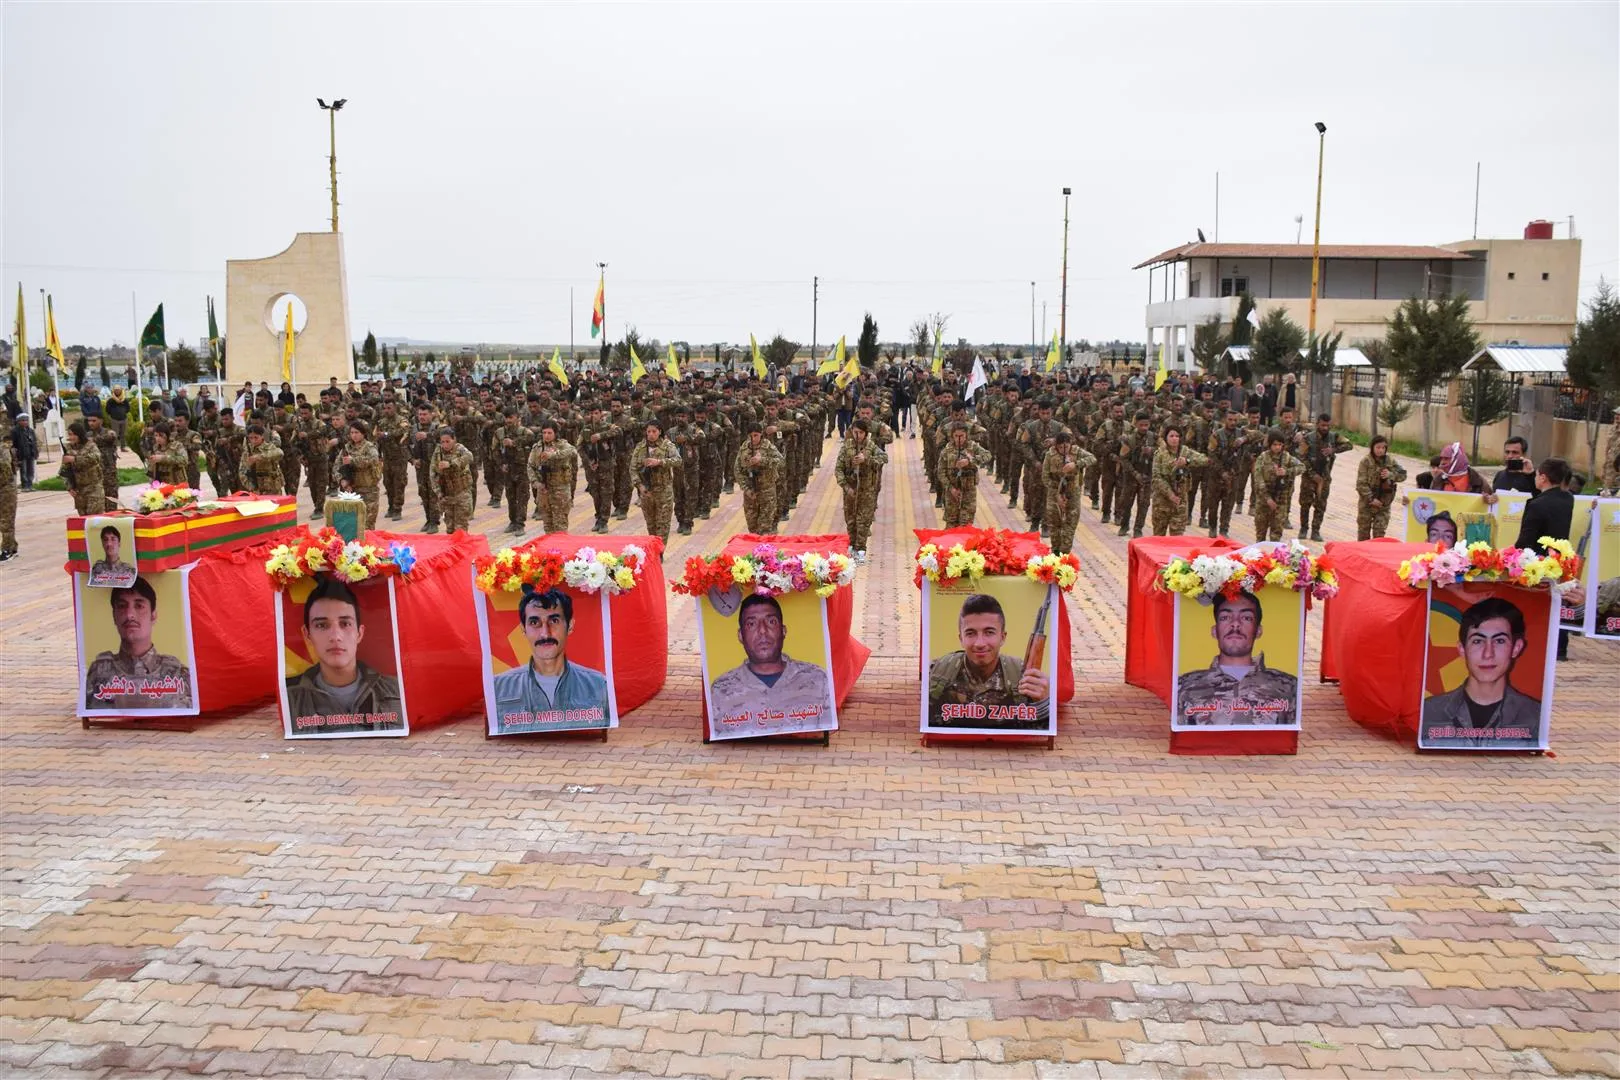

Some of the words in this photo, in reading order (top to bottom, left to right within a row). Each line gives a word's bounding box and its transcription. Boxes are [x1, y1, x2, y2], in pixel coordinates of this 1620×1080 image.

[94, 675, 136, 699] دلشير
[140, 675, 184, 699] الشهيد
[788, 703, 824, 721] الشهيد
[942, 702, 987, 721] ŞEHÎD
[988, 703, 1037, 720] ZAFÊR
[1224, 698, 1251, 716] بشار
[1253, 698, 1289, 715] الشهيد
[536, 709, 564, 724] AMED
[722, 710, 753, 727] العبيد
[756, 708, 785, 726] صالح
